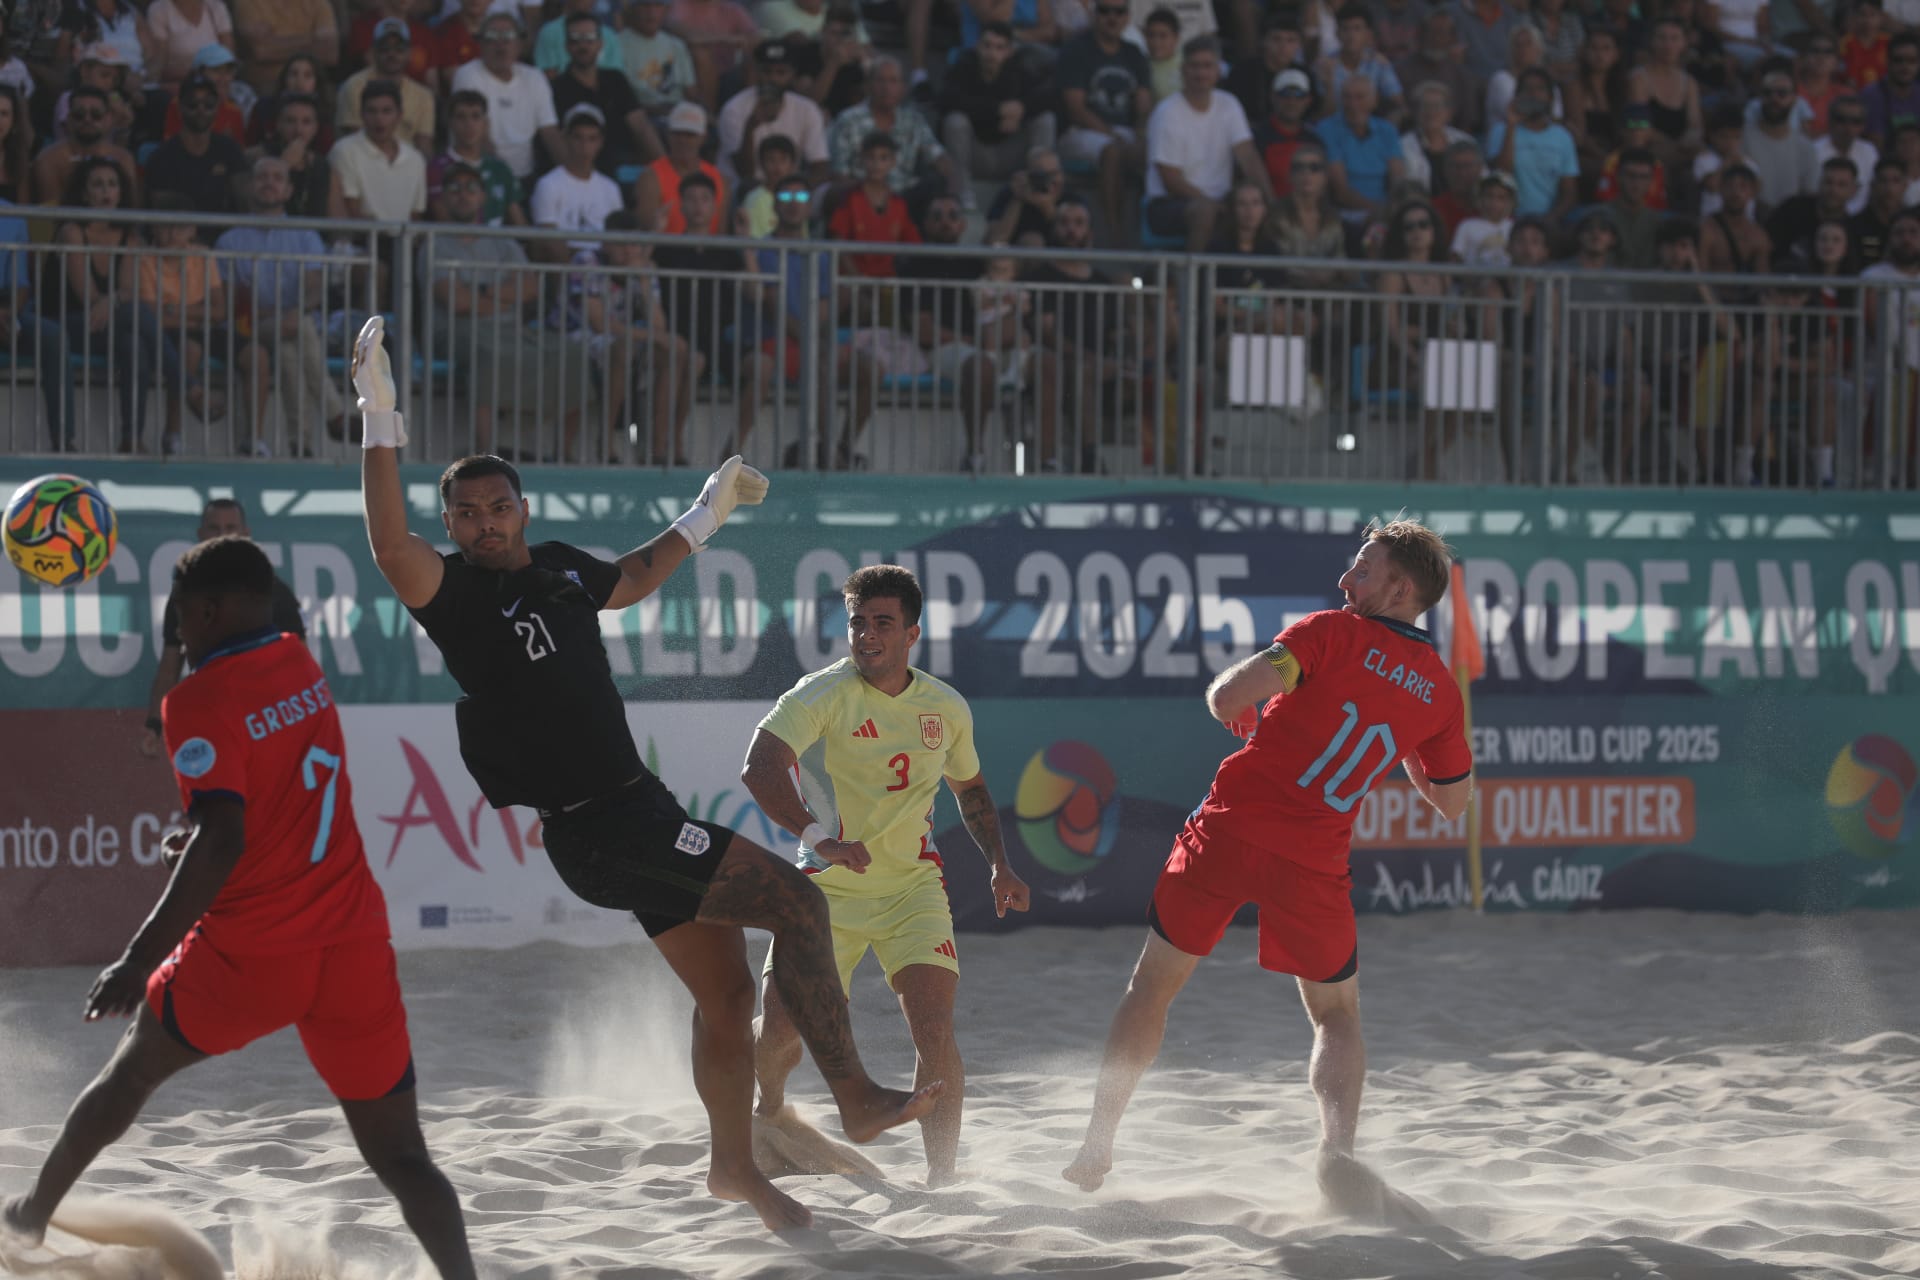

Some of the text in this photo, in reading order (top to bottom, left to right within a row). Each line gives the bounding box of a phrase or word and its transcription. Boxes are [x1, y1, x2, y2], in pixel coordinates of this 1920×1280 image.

[514, 612, 557, 661] 21
[794, 550, 985, 679] CP
[1015, 551, 1256, 680] 2025
[1363, 648, 1436, 705] CLARKE
[886, 752, 910, 792] 3
[1296, 700, 1397, 813] 10
[1505, 727, 1597, 764] WORLD
[1602, 726, 1653, 763] CUP
[1656, 726, 1720, 763] 2025
[302, 745, 340, 864] 7
[1493, 784, 1682, 843] QUALIFIER
[69, 815, 120, 868] de
[1532, 857, 1604, 901] CÁDIZ
